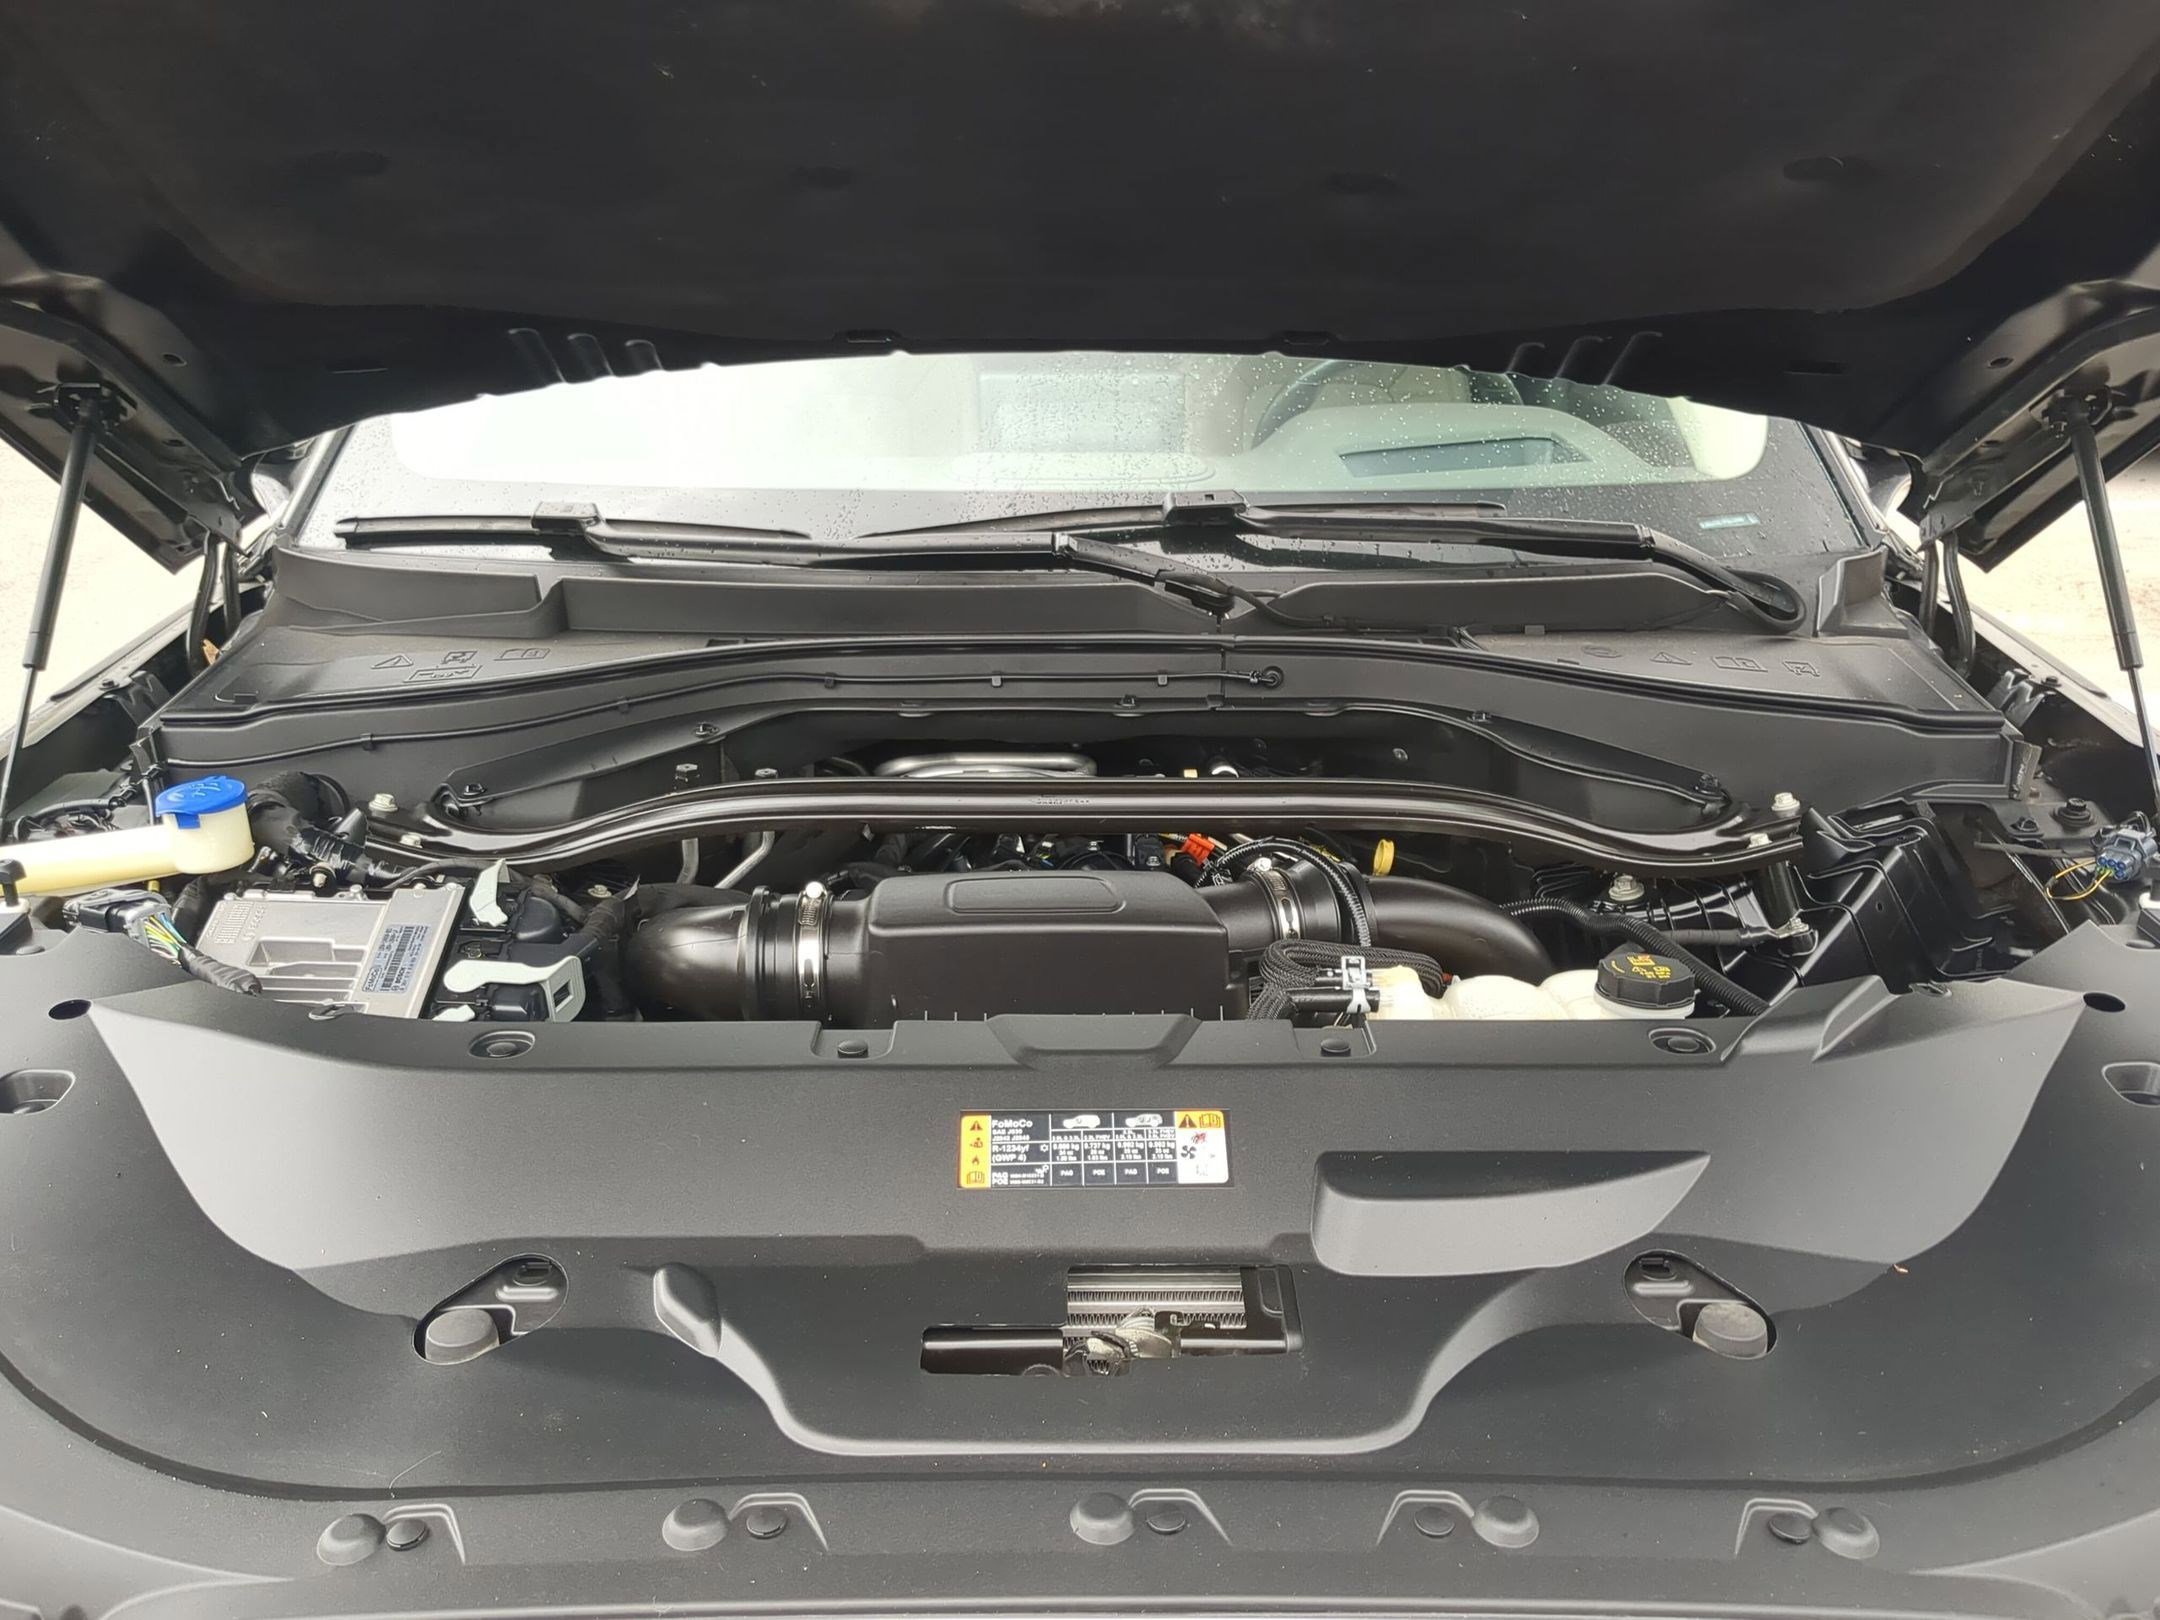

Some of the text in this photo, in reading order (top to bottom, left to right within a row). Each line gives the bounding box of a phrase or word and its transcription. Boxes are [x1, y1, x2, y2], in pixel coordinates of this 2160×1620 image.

[991, 1119, 1033, 1129] FoMoCo
[991, 1144, 1030, 1153] R-1234yf
[1071, 1143, 1080, 1151] kg
[1102, 1142, 1110, 1151] kg
[991, 1154, 1027, 1163] (GWP 4)
